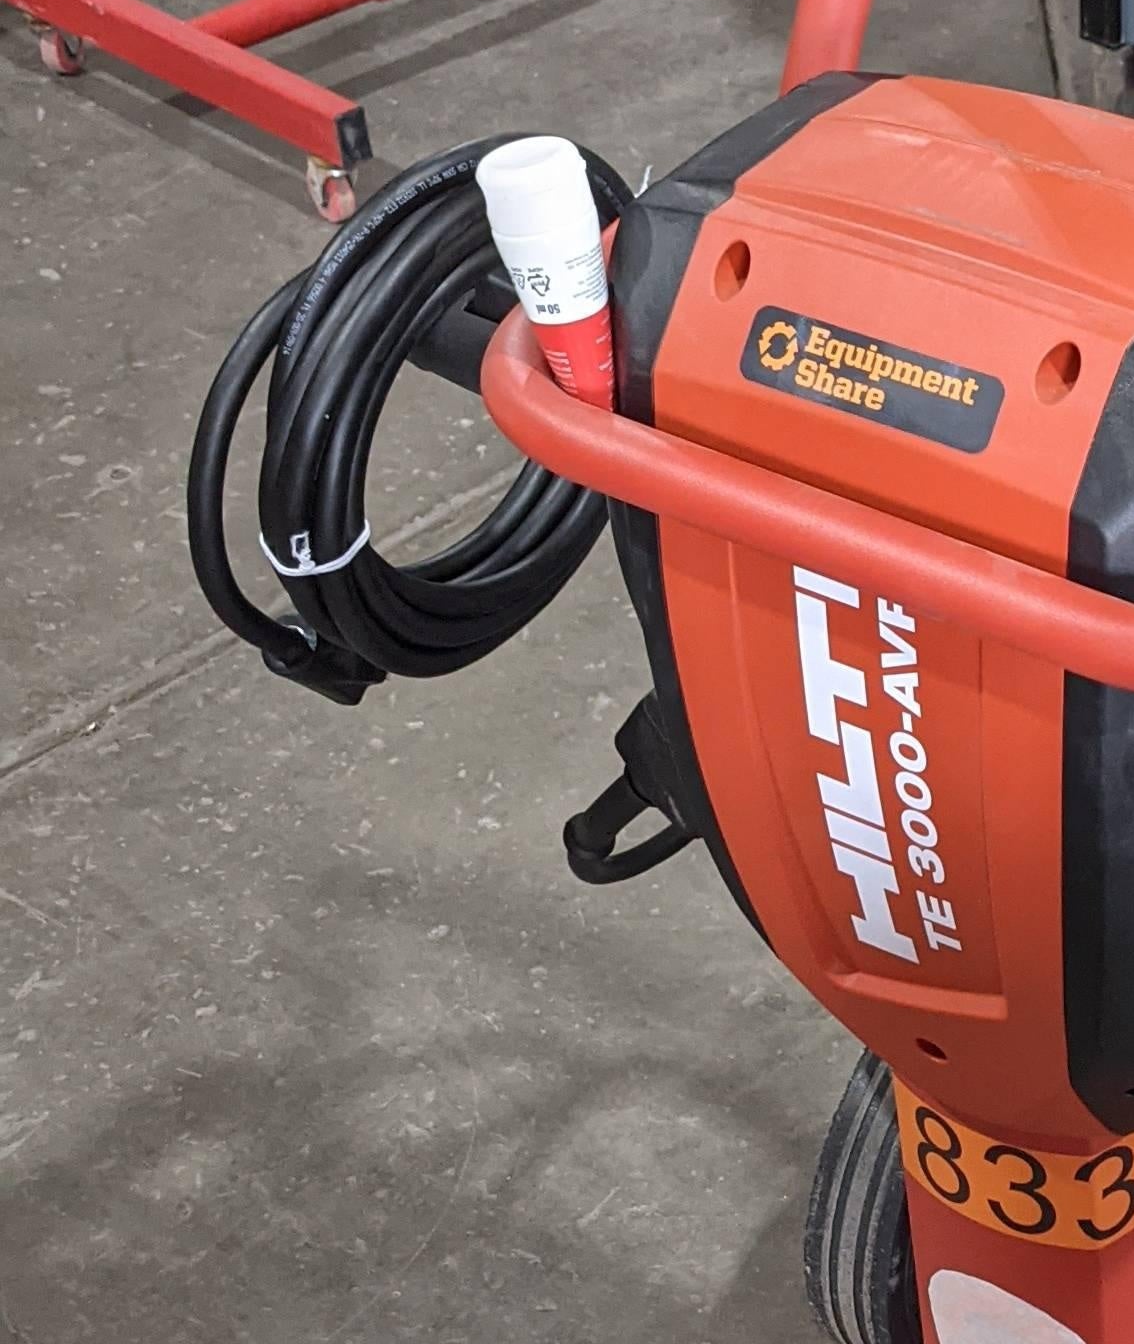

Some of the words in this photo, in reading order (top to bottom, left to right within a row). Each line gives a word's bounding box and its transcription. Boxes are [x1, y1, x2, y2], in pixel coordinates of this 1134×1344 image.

[794, 358, 886, 411] Share
[804, 325, 980, 406] Equipment
[792, 564, 921, 965] HILTI
[915, 889, 963, 952] TE
